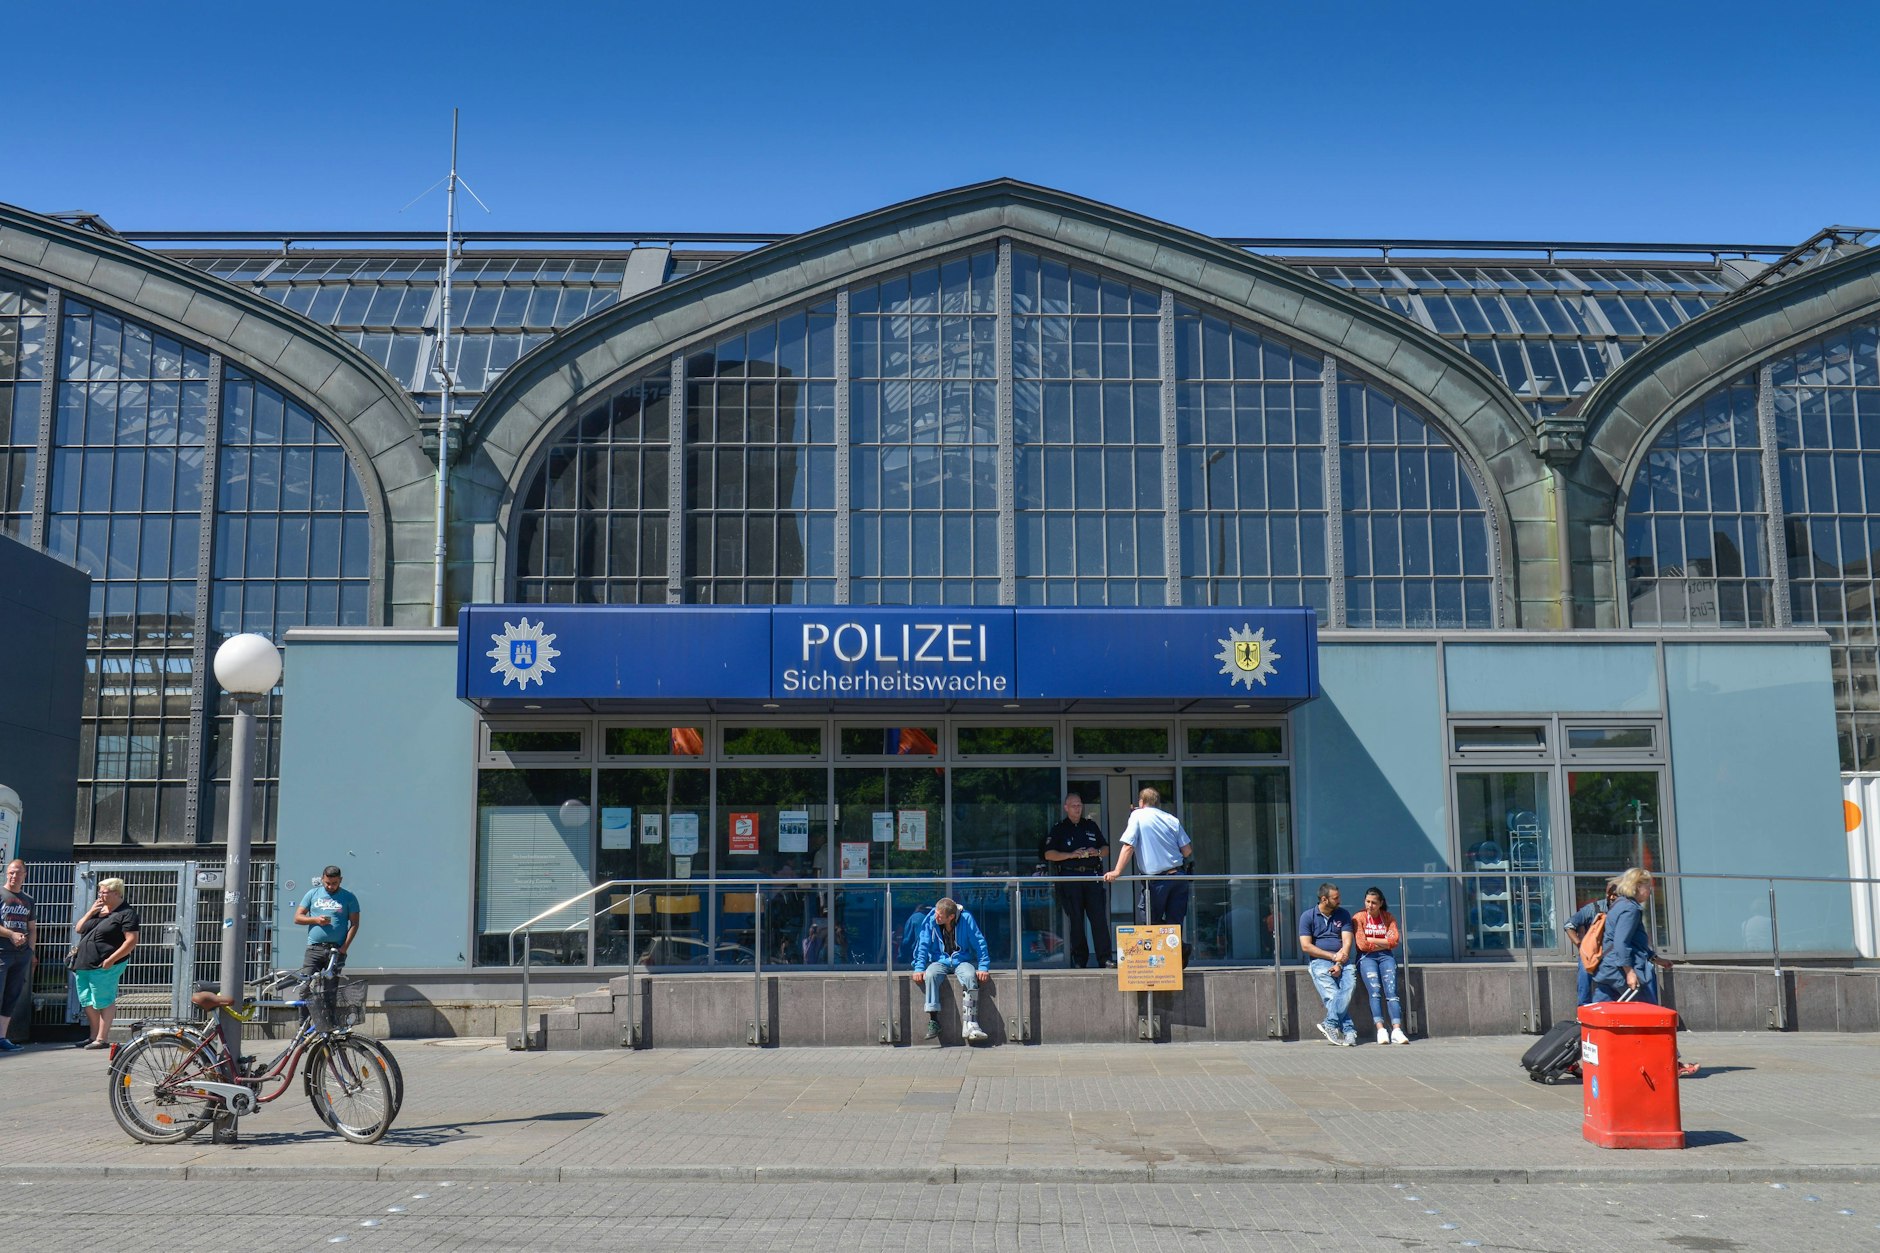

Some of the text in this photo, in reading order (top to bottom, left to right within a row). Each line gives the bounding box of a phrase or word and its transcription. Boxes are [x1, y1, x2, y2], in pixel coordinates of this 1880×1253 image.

[802, 622, 986, 662] POLIZEI
[783, 669, 1007, 692] Sicherheitswache
[229, 853, 240, 865] 14
